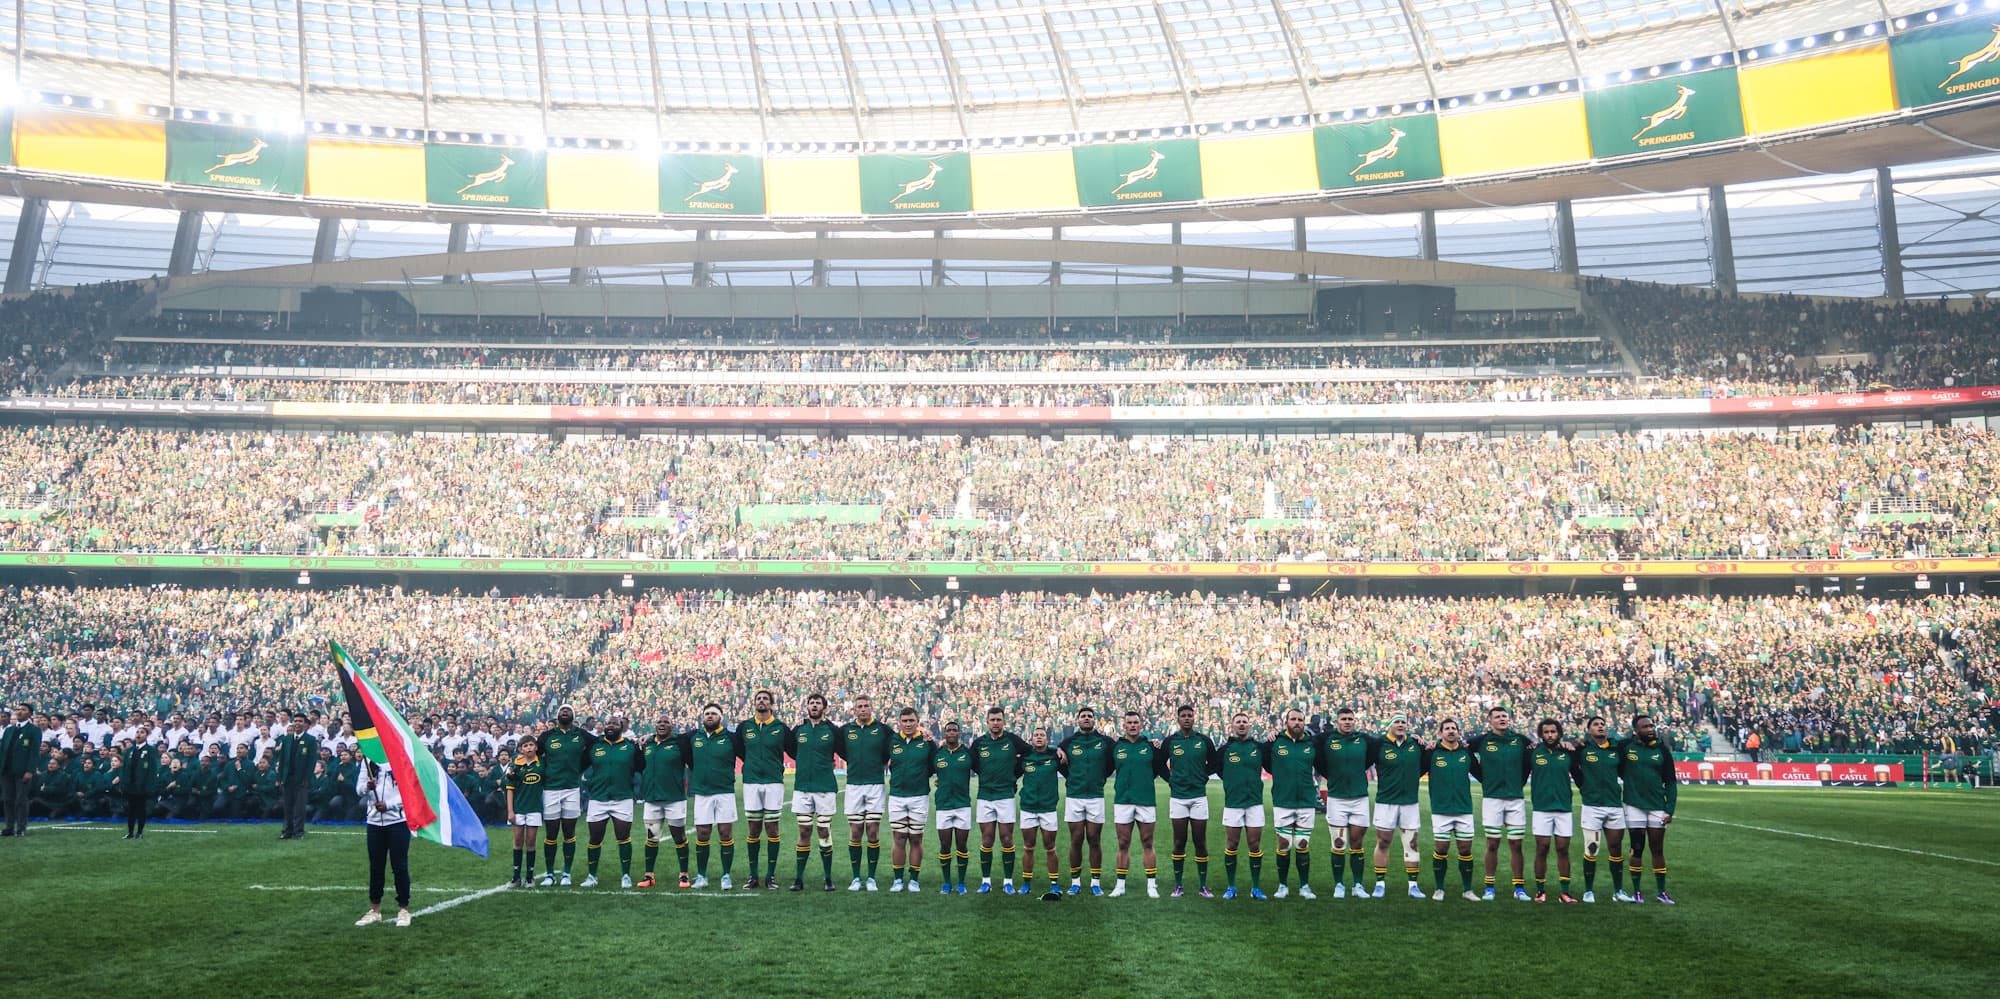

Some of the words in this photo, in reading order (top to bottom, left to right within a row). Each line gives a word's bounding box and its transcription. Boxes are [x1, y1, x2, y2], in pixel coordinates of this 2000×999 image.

[1946, 77, 2000, 94] SPRINGBO
[1638, 132, 1695, 147] SPRINGBOKS
[209, 174, 261, 186] SPRINGBOKS
[1354, 171, 1405, 182] SPRINGBOKS
[461, 194, 509, 203] SPRINGBOKS
[1116, 191, 1163, 200] SPRINGBOKS
[688, 201, 734, 210] SPRINGBOKS
[1932, 392, 1960, 400] CASTLE
